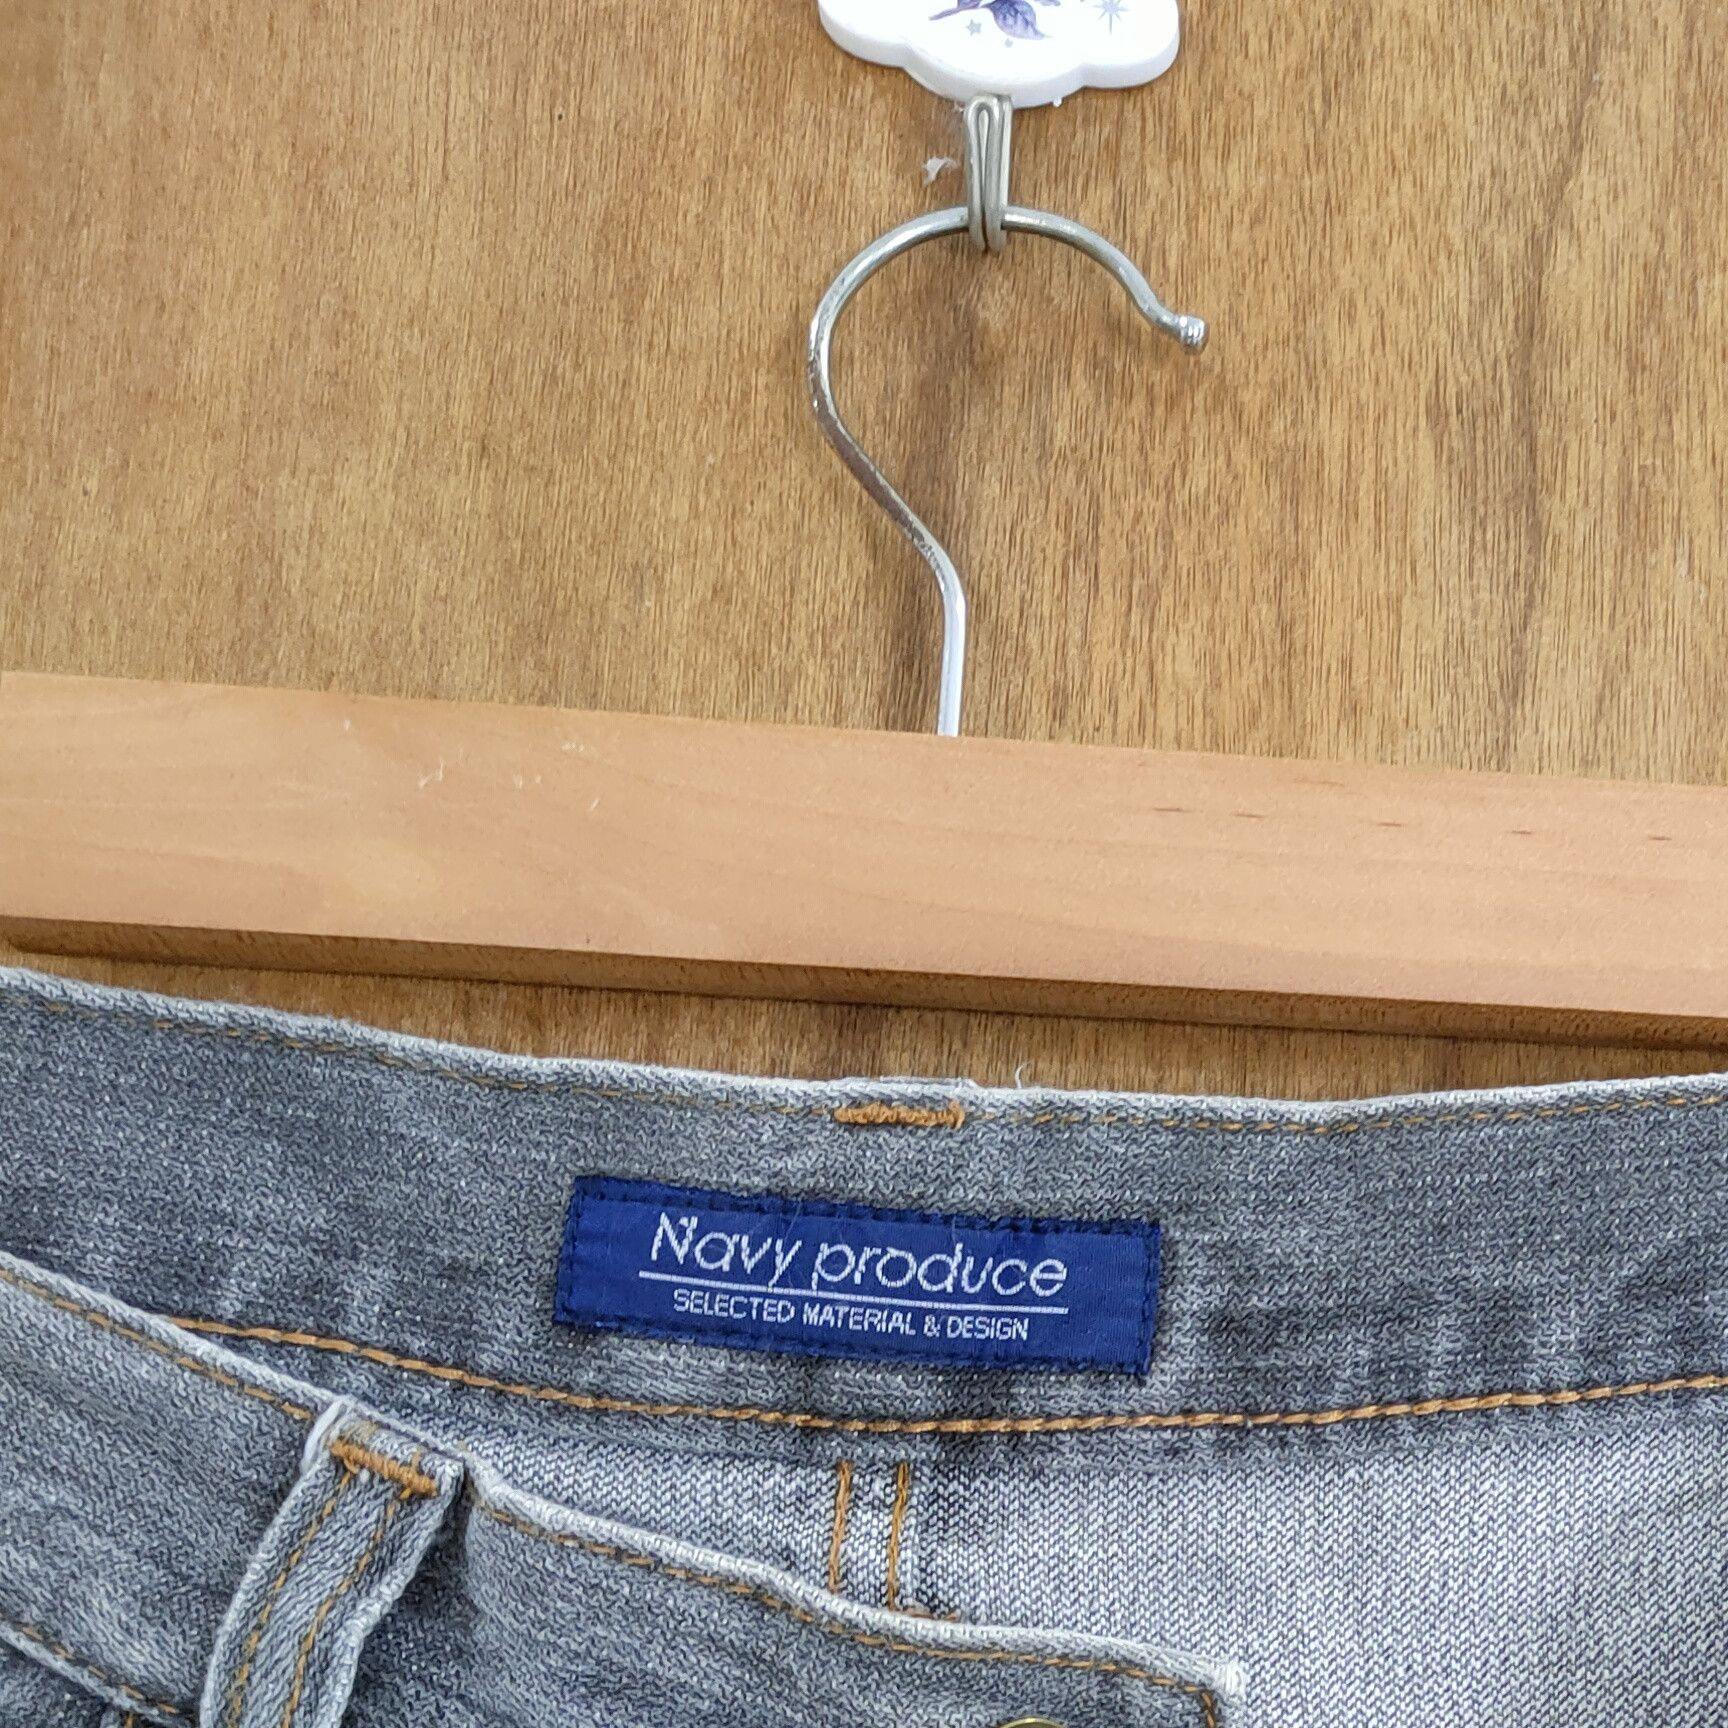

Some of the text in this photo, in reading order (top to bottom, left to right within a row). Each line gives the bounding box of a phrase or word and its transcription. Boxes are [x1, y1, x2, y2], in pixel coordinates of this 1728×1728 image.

[650, 1211, 1069, 1298] Navy produce
[673, 1288, 1029, 1342] SELECTED MATERIAL & DESIGN
